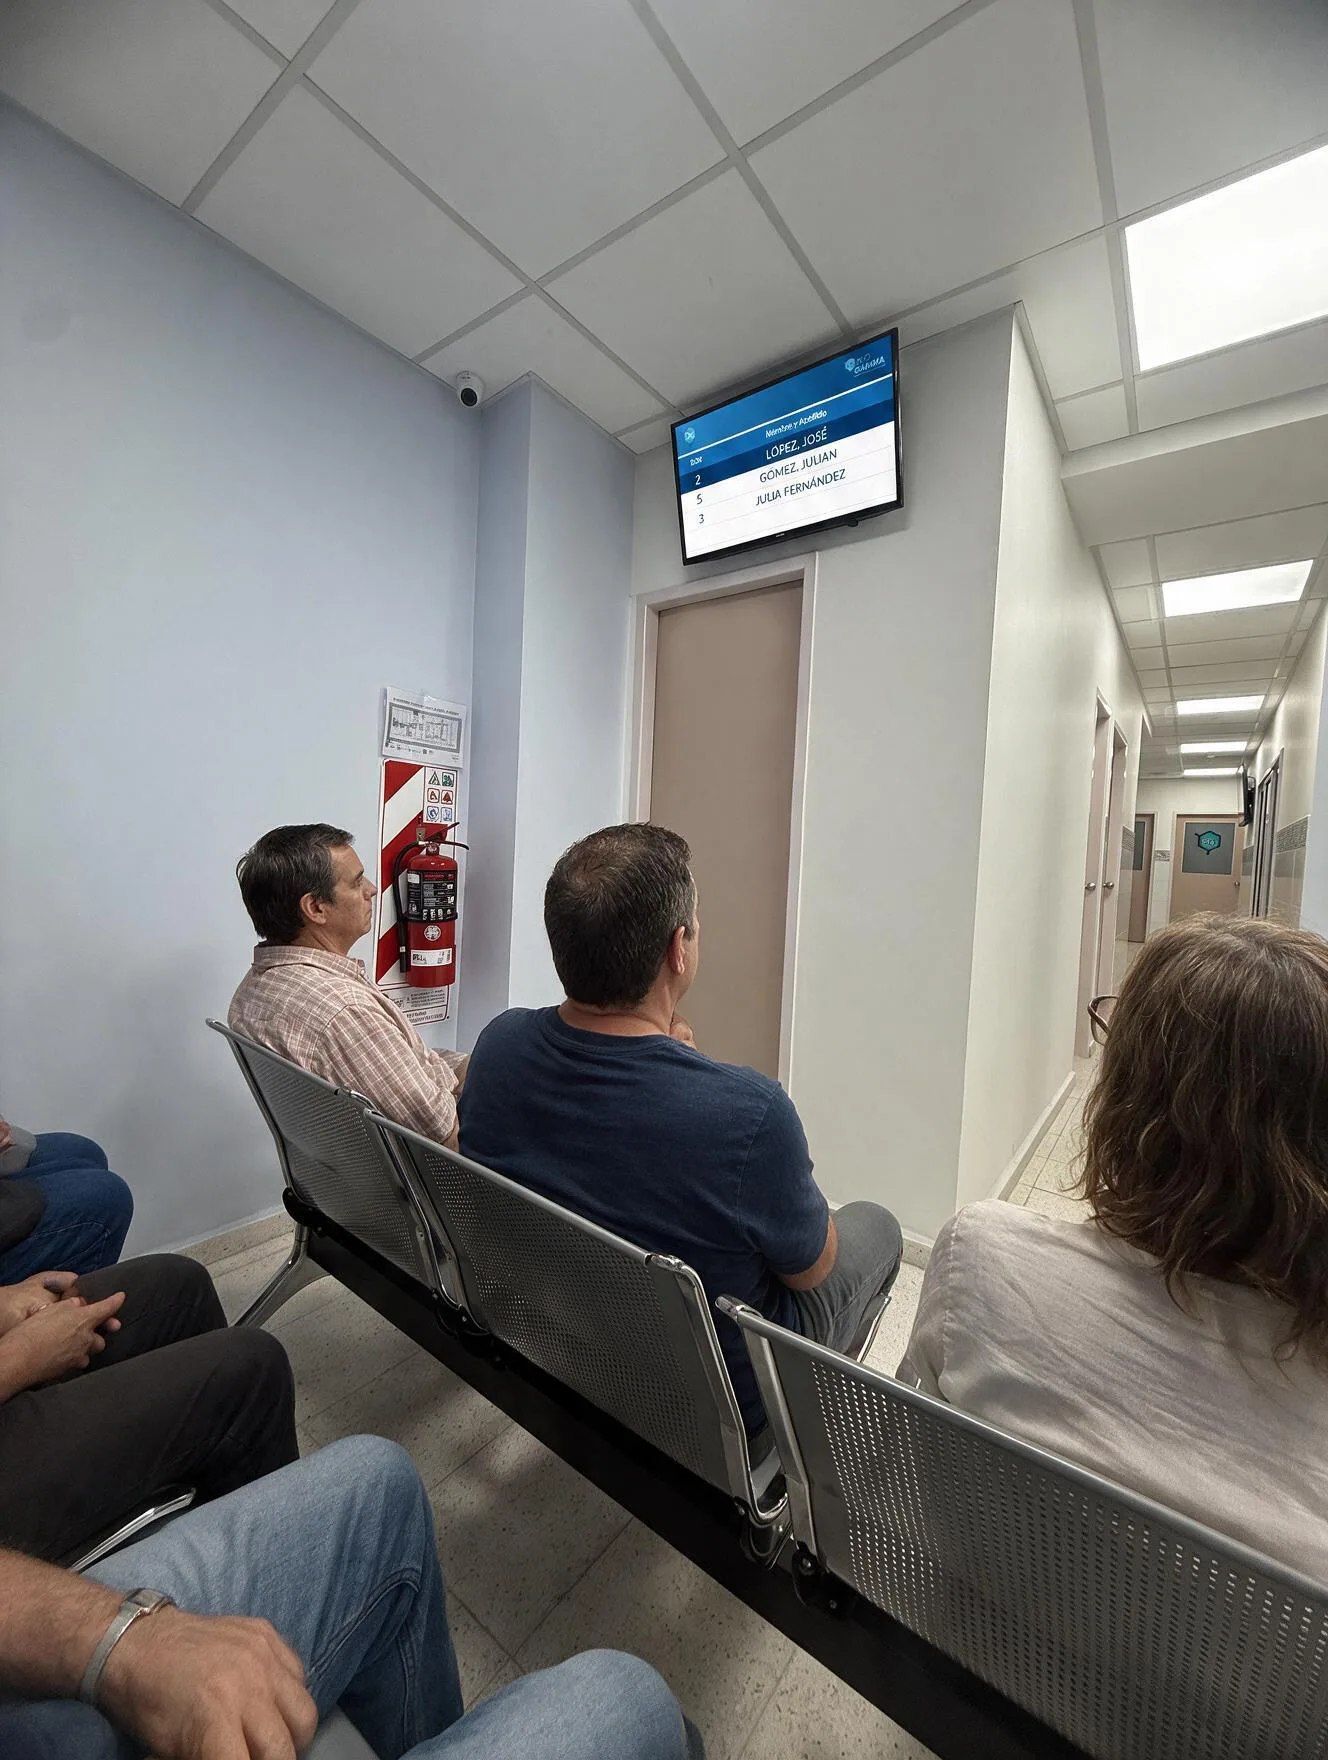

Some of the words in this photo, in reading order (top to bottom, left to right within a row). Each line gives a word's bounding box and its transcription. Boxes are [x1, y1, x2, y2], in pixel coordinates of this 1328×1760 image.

[802, 426, 828, 448] JOSÉ
[801, 449, 837, 470] JULIAN
[695, 474, 701, 486] 2
[756, 490, 781, 507] JULIA
[784, 468, 846, 497] FERNÁNDEZ
[696, 493, 703, 505] 5
[698, 513, 705, 524] 3
